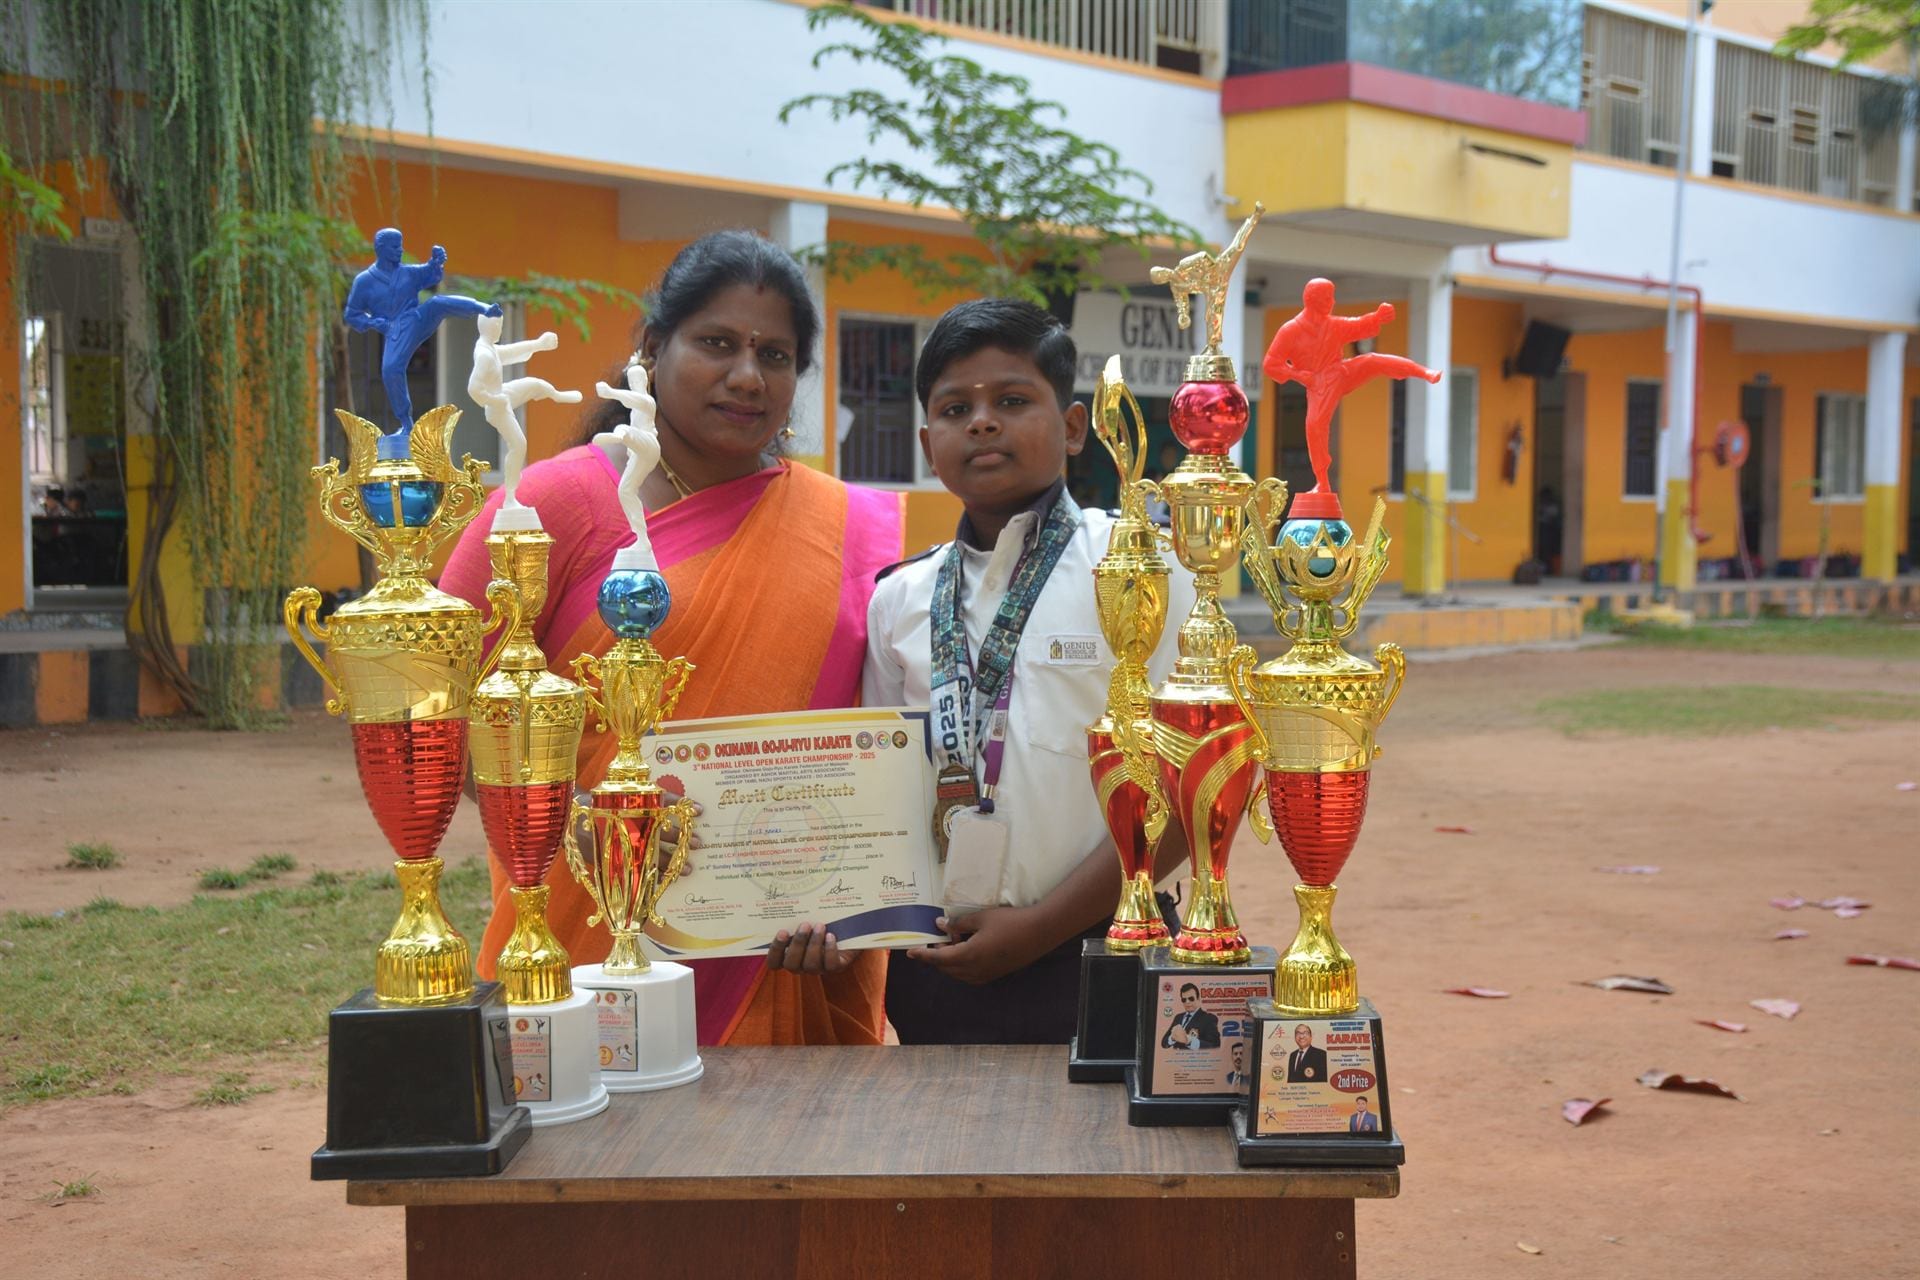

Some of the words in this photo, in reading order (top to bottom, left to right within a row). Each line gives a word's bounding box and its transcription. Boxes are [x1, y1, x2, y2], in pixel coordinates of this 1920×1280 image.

[1064, 642, 1096, 650] GENIUS
[714, 741, 760, 758] OKINAWA
[814, 735, 852, 750] KARATE
[701, 762, 733, 770] NATIONAL
[734, 760, 754, 768] LEVEL
[756, 758, 774, 766] OPEN
[775, 756, 800, 764] KARATE
[802, 752, 854, 762] CHAMPIONSHIP
[718, 789, 766, 809] Merit
[771, 783, 856, 802] Certificate
[1200, 987, 1268, 998] KARATE
[1326, 1034, 1370, 1044] KARATE
[1338, 1074, 1350, 1088] 2nd
[1351, 1074, 1368, 1088] Prize
